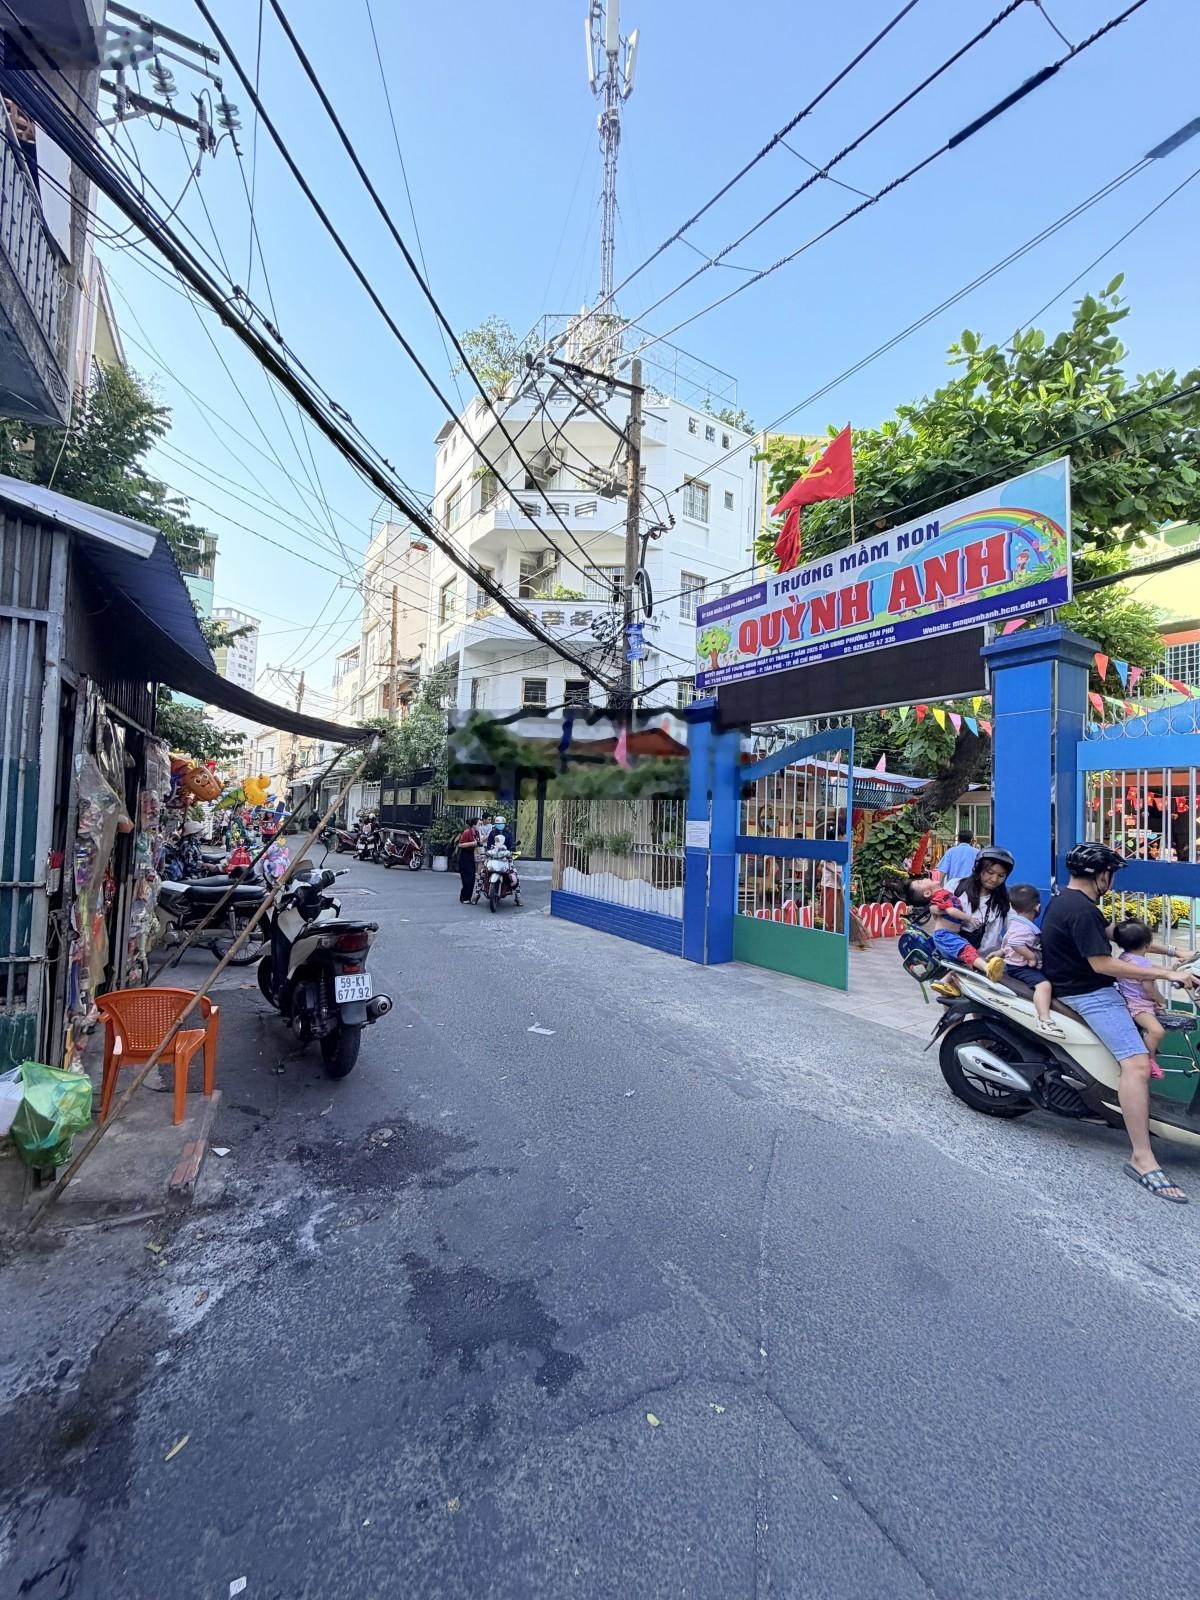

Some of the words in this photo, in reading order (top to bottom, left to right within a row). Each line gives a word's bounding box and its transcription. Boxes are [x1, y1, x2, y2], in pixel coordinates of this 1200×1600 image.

[773, 563, 833, 597] TRƯỜNG
[840, 540, 889, 572] MẦM
[897, 520, 940, 552] NON
[738, 580, 873, 656] QUỲNH
[887, 532, 1012, 614] ANH
[922, 622, 952, 634] Website:
[952, 597, 1048, 628] mnquynhanh.hcm.edu.vn
[846, 633, 868, 644] PHƯỜNG
[869, 630, 881, 639] TÂN
[882, 626, 894, 635] PHÚ
[338, 987, 370, 1000] 677.92
[341, 976, 364, 988] 59-K1
